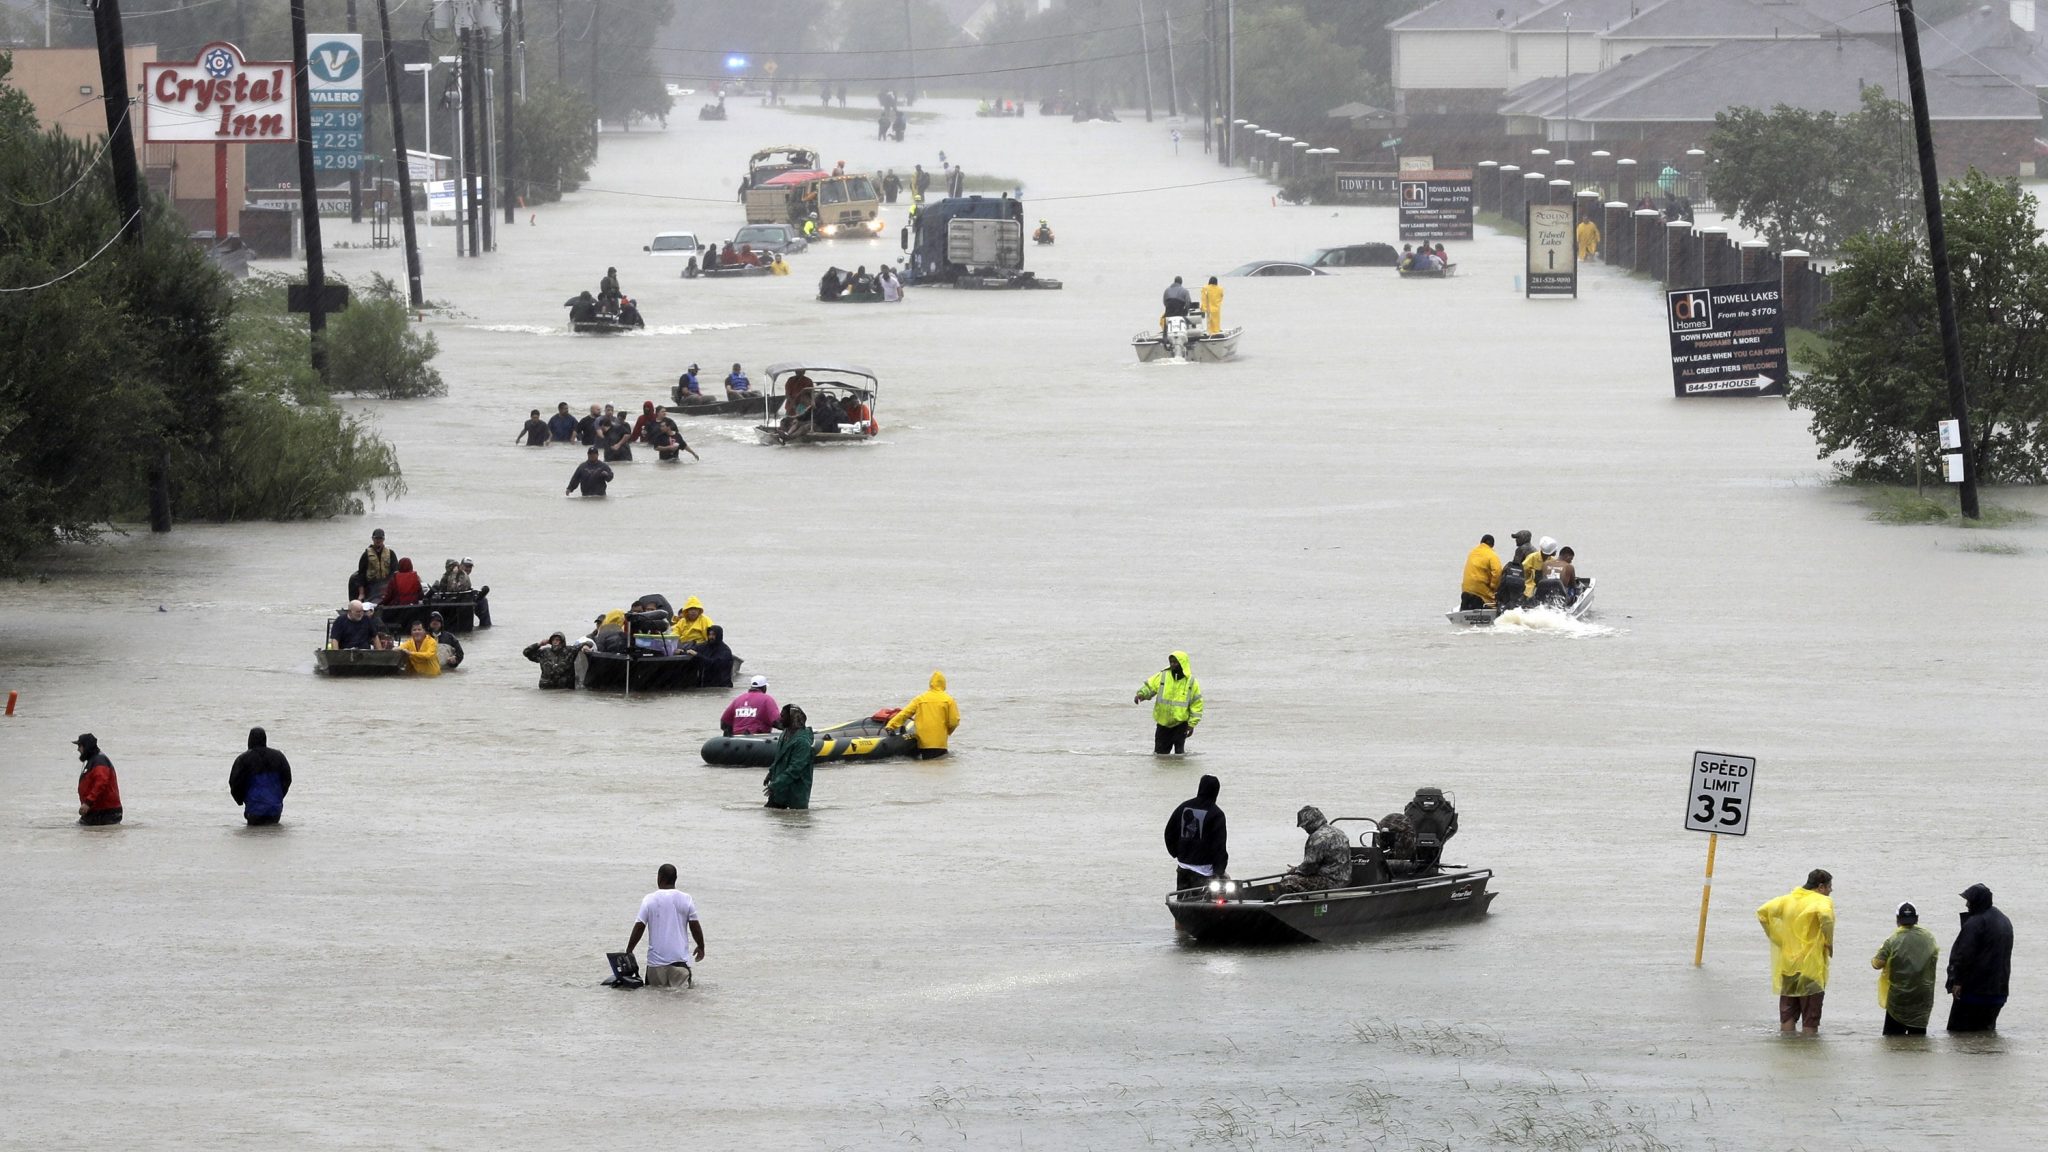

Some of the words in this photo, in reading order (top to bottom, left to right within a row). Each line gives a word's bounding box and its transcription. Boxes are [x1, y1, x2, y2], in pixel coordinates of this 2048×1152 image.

[156, 68, 284, 112] Crystal
[310, 92, 359, 102] VALERO
[214, 104, 284, 137] Inn
[320, 202, 350, 211] ANCH
[1713, 294, 1749, 304] TIDWELL
[1751, 291, 1778, 301] LAKES
[1751, 307, 1776, 317] $170s
[1676, 320, 1707, 329] Homes
[1702, 331, 1732, 340] PAYMENT
[1732, 328, 1773, 337] ASSISTANCE
[1695, 339, 1732, 348] PROGRAMS
[1742, 362, 1777, 370] WELCOME!
[1688, 379, 1756, 392] 844-91-HOUSE
[1700, 761, 1748, 777] SPEED
[1703, 778, 1740, 792] LIMIT
[1693, 795, 1742, 825] 35
